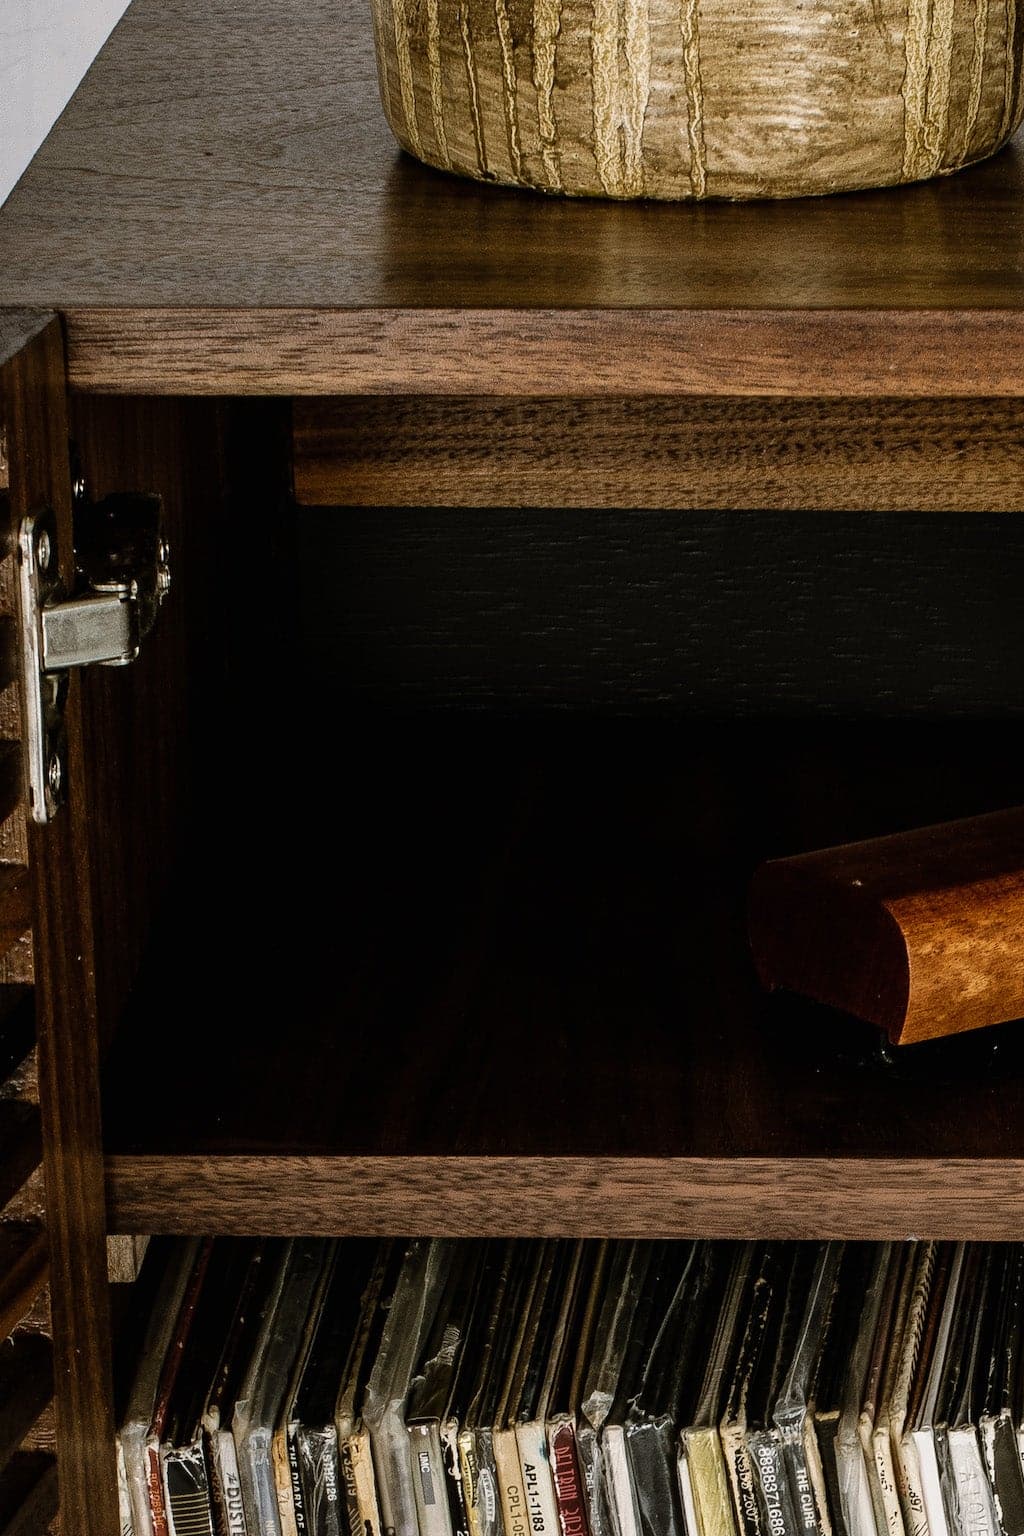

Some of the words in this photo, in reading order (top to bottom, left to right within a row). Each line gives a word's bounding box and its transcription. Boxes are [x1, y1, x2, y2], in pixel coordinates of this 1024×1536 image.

[322, 1454, 338, 1501] STH2126
[523, 1463, 545, 1531] APL1-1183
[795, 1468, 809, 1490] THE
[799, 1493, 816, 1527] CURE
[964, 1492, 987, 1536] LOVE
